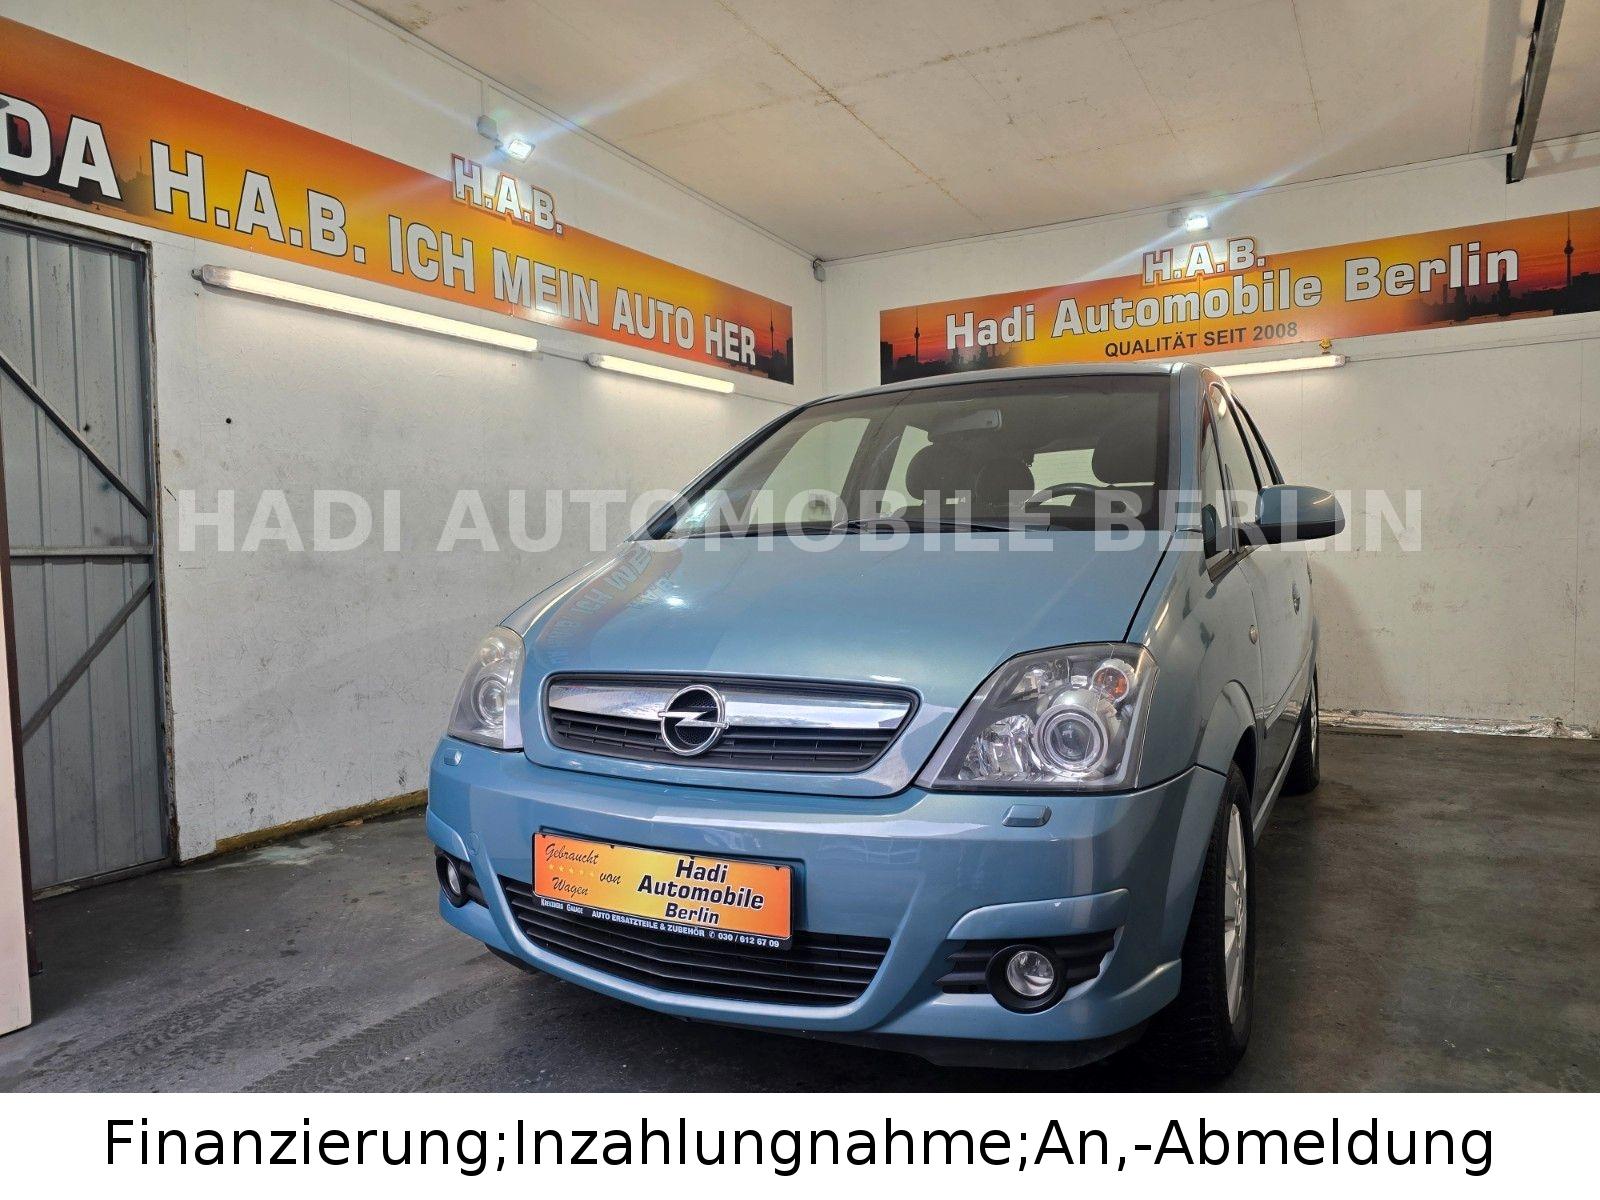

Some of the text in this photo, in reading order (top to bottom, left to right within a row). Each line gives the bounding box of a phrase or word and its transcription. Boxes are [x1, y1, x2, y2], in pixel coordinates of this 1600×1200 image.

[452, 154, 564, 234] H.A.B.
[0, 91, 757, 366] DA H.A.B. ICH MEIN AUTO HER
[1144, 237, 1266, 284] H.A.B.
[946, 241, 1519, 350] Hadi Automobile Berlin
[1105, 321, 1298, 357] QUALITÄT SEIT 2008
[545, 843, 599, 865] Gebraucht
[675, 859, 728, 883] Hadi
[552, 877, 589, 898] Wagen
[600, 872, 621, 885] von
[637, 874, 764, 910] Automobile
[592, 910, 611, 920] AUTO
[611, 913, 659, 930] ERSATZTEILE
[659, 923, 666, 931] &
[667, 923, 705, 937] ZUBEHÖR
[718, 932, 733, 942] 030
[740, 935, 755, 944] 612
[768, 939, 780, 948] 09
[665, 902, 720, 925] Berlin
